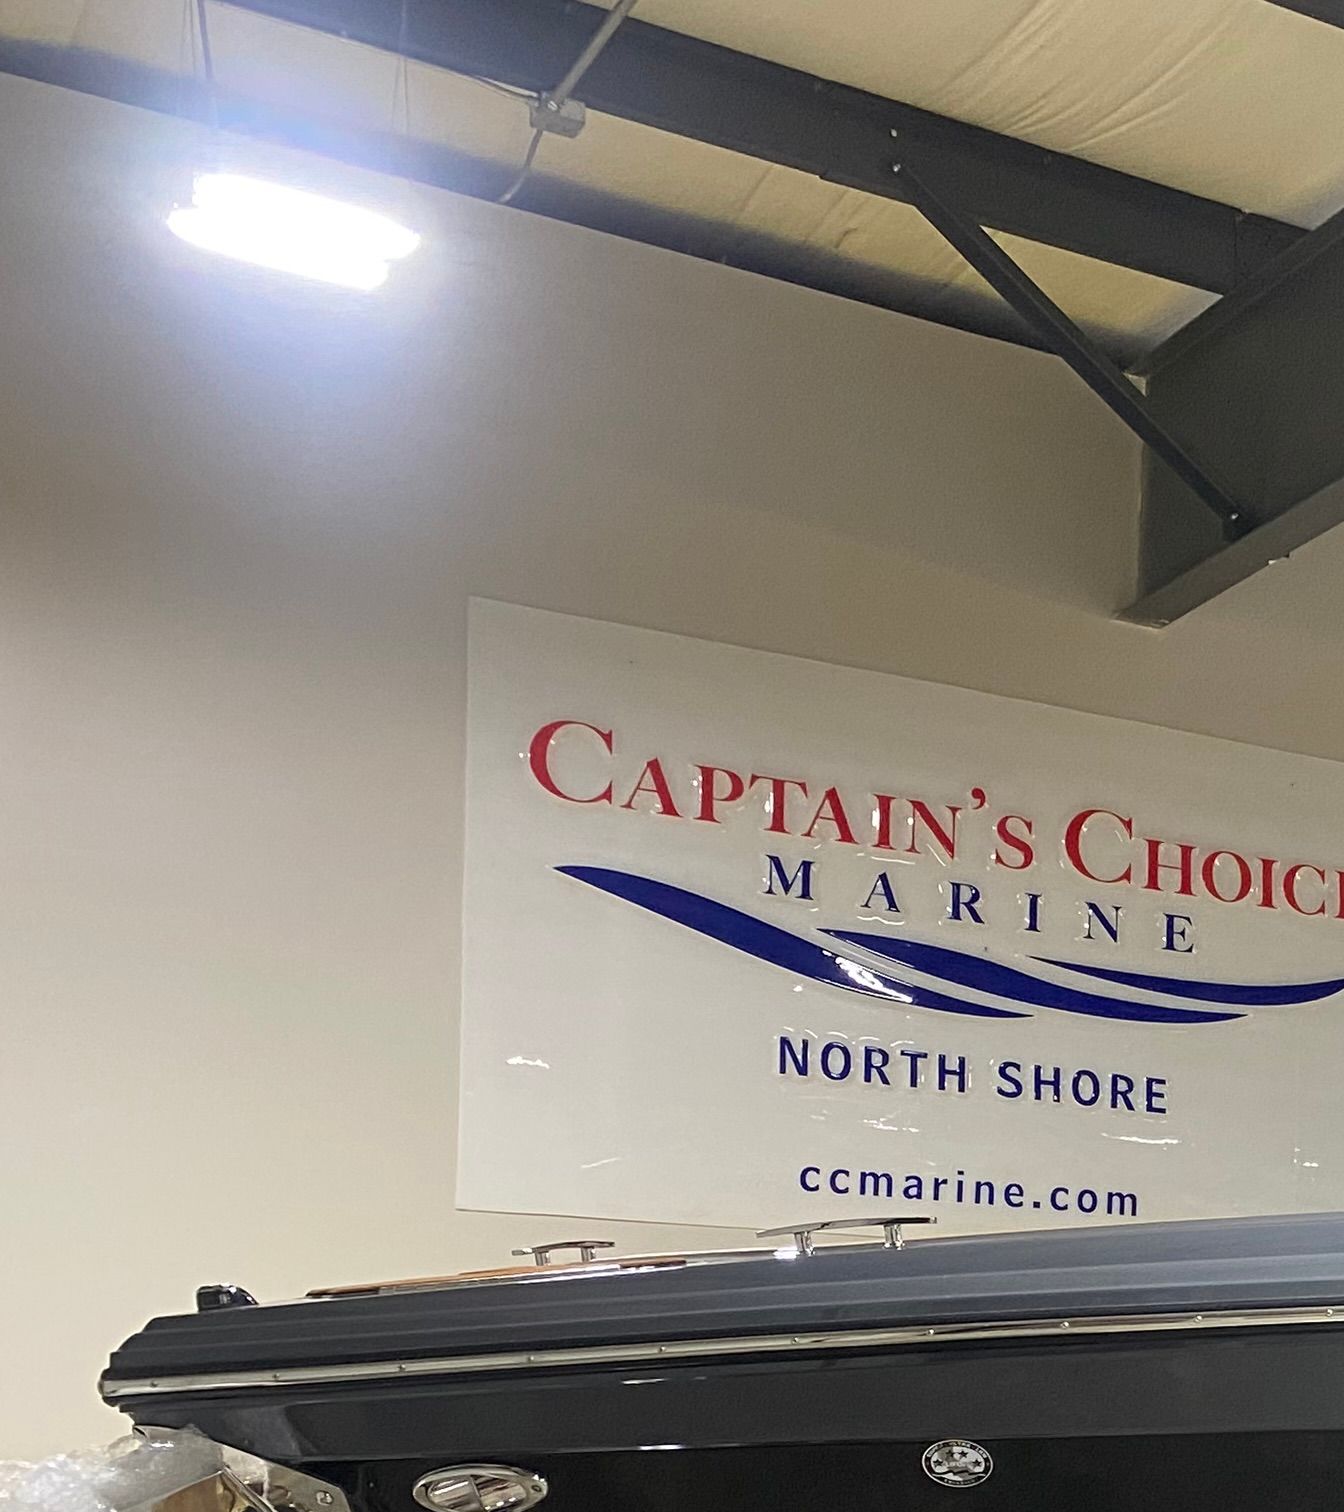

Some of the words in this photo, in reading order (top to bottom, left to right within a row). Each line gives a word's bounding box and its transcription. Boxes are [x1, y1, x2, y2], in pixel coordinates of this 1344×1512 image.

[528, 719, 1035, 870] CAPTAIN'S
[764, 853, 1196, 955] MARINE
[777, 1034, 968, 1094] NORTH
[995, 1060, 1168, 1115] SHORE
[799, 1164, 1140, 1218] ccmarine.com
